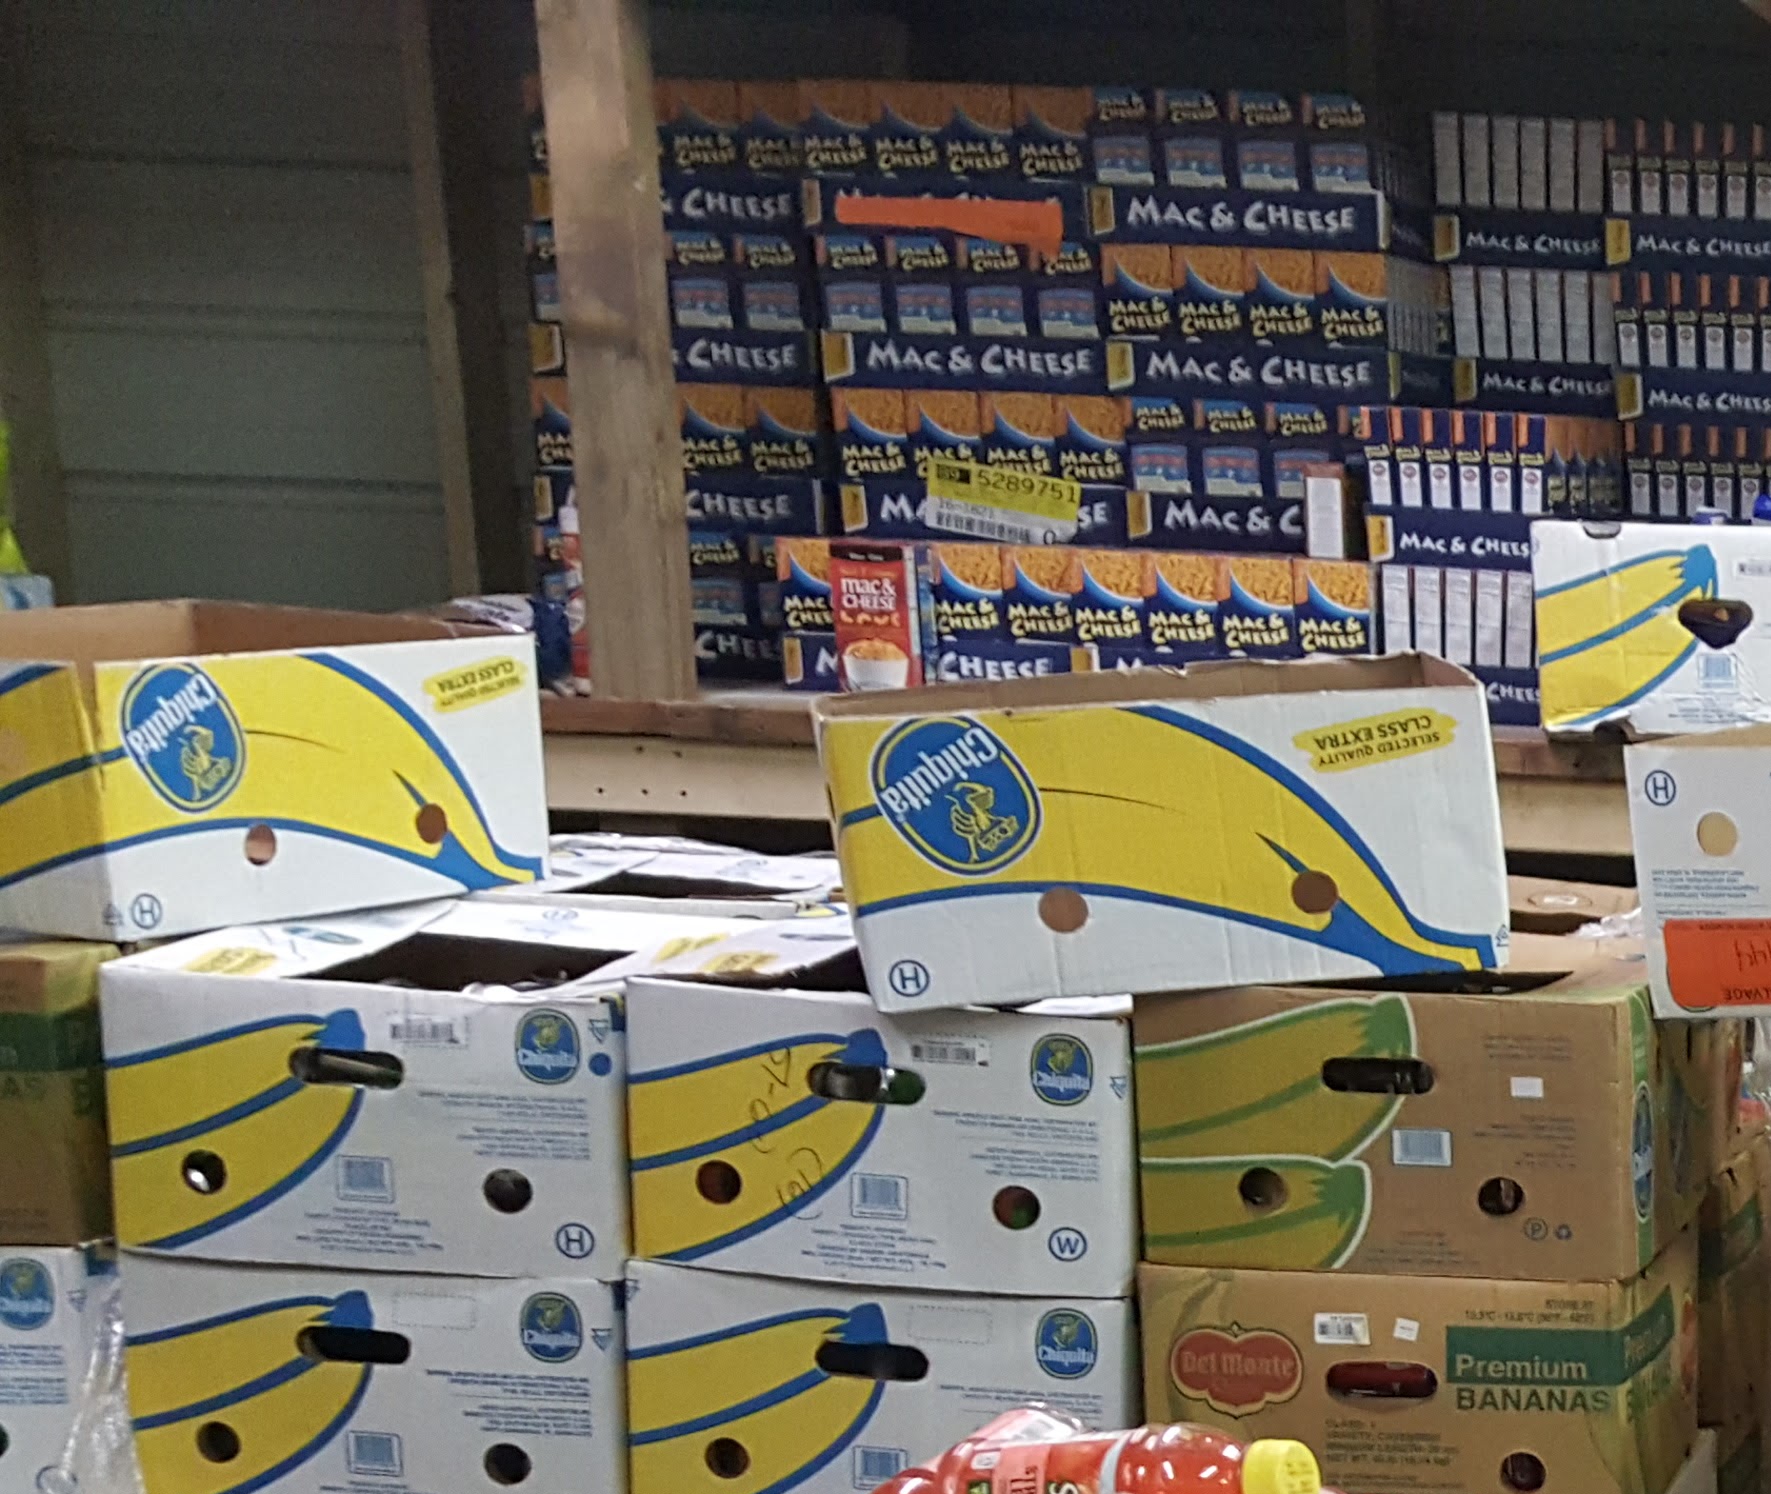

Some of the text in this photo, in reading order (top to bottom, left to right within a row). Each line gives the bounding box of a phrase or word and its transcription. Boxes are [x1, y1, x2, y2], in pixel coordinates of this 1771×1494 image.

[978, 470, 1076, 503] 5289751
[1472, 536, 1529, 556] CHEES
[128, 674, 218, 762] Chiquita
[1314, 715, 1432, 748] CLASS EXTRA
[1377, 731, 1440, 753] SELECTED
[880, 726, 998, 818] Chiquita
[1182, 1350, 1293, 1378] Del Monte
[1456, 1354, 1588, 1381] Premium
[1457, 1387, 1610, 1411] BANANAS
